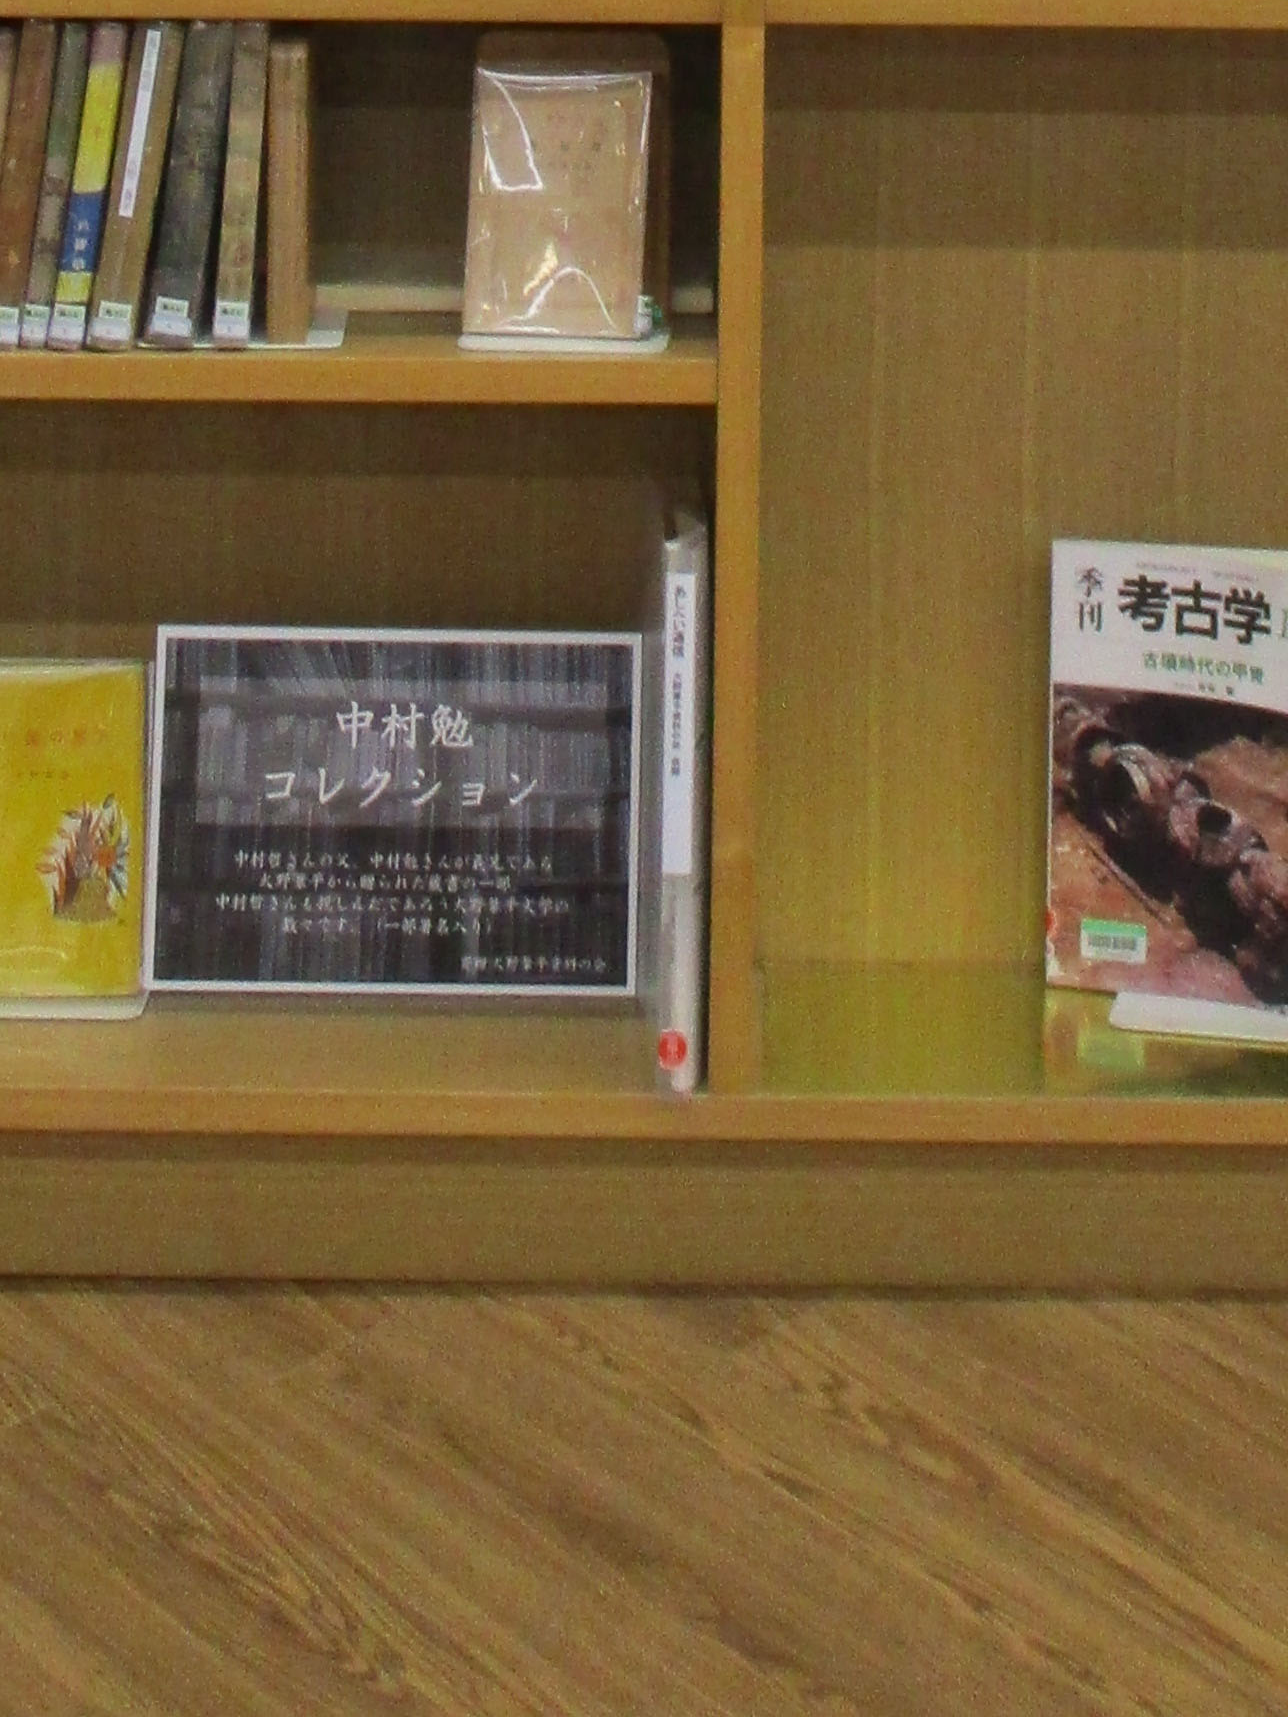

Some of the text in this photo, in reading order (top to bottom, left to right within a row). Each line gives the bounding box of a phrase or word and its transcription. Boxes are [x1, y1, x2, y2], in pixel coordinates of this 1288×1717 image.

[1074, 566, 1104, 633] 季刊
[1118, 575, 1272, 646] 考古学
[263, 767, 541, 809] コレクション
